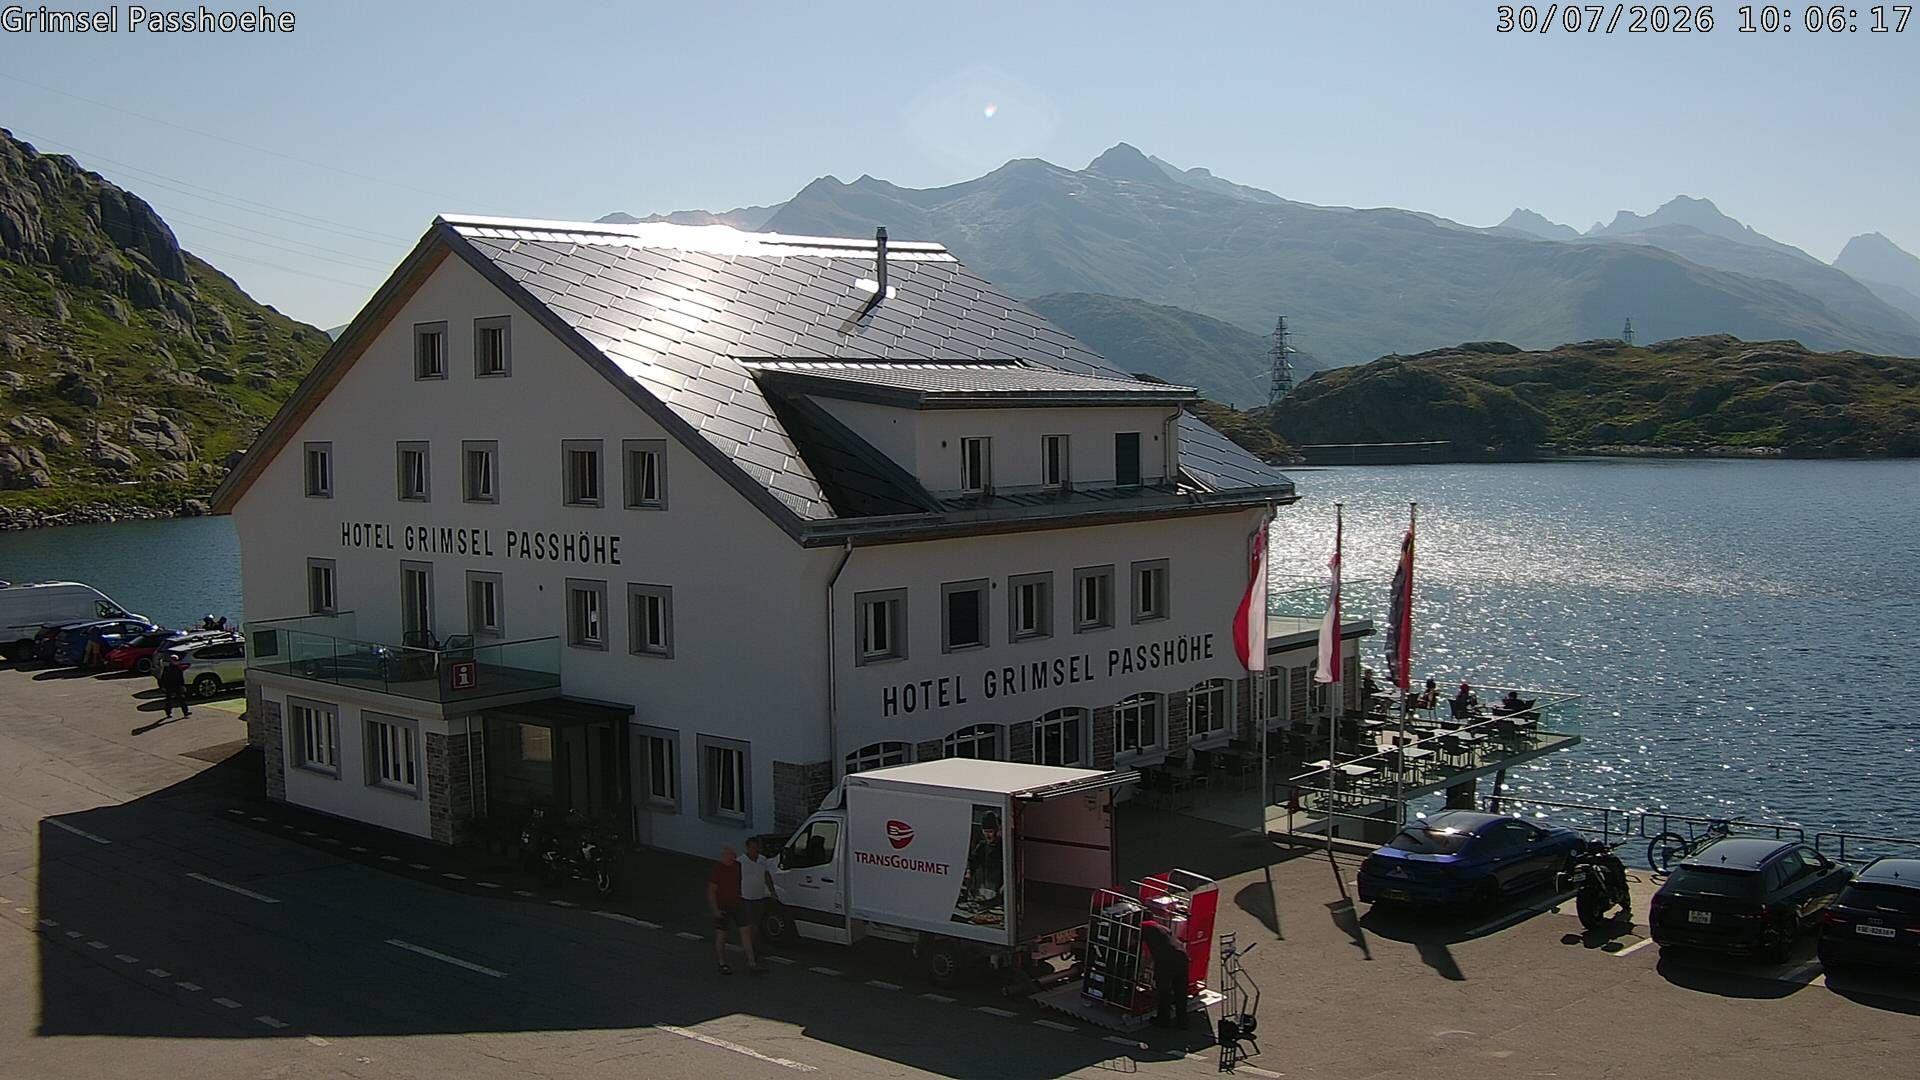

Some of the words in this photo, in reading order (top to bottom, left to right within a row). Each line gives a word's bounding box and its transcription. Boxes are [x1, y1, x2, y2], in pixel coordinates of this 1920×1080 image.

[341, 522, 394, 549] HOTEL
[404, 525, 493, 556] GRIMSEL
[507, 530, 621, 565] PASSHÖHE
[883, 675, 967, 717] HOTEL
[984, 653, 1094, 699] GRIMSEL
[1108, 633, 1214, 677] PASSHÖHE
[854, 851, 950, 876] TRANSGOURMET
